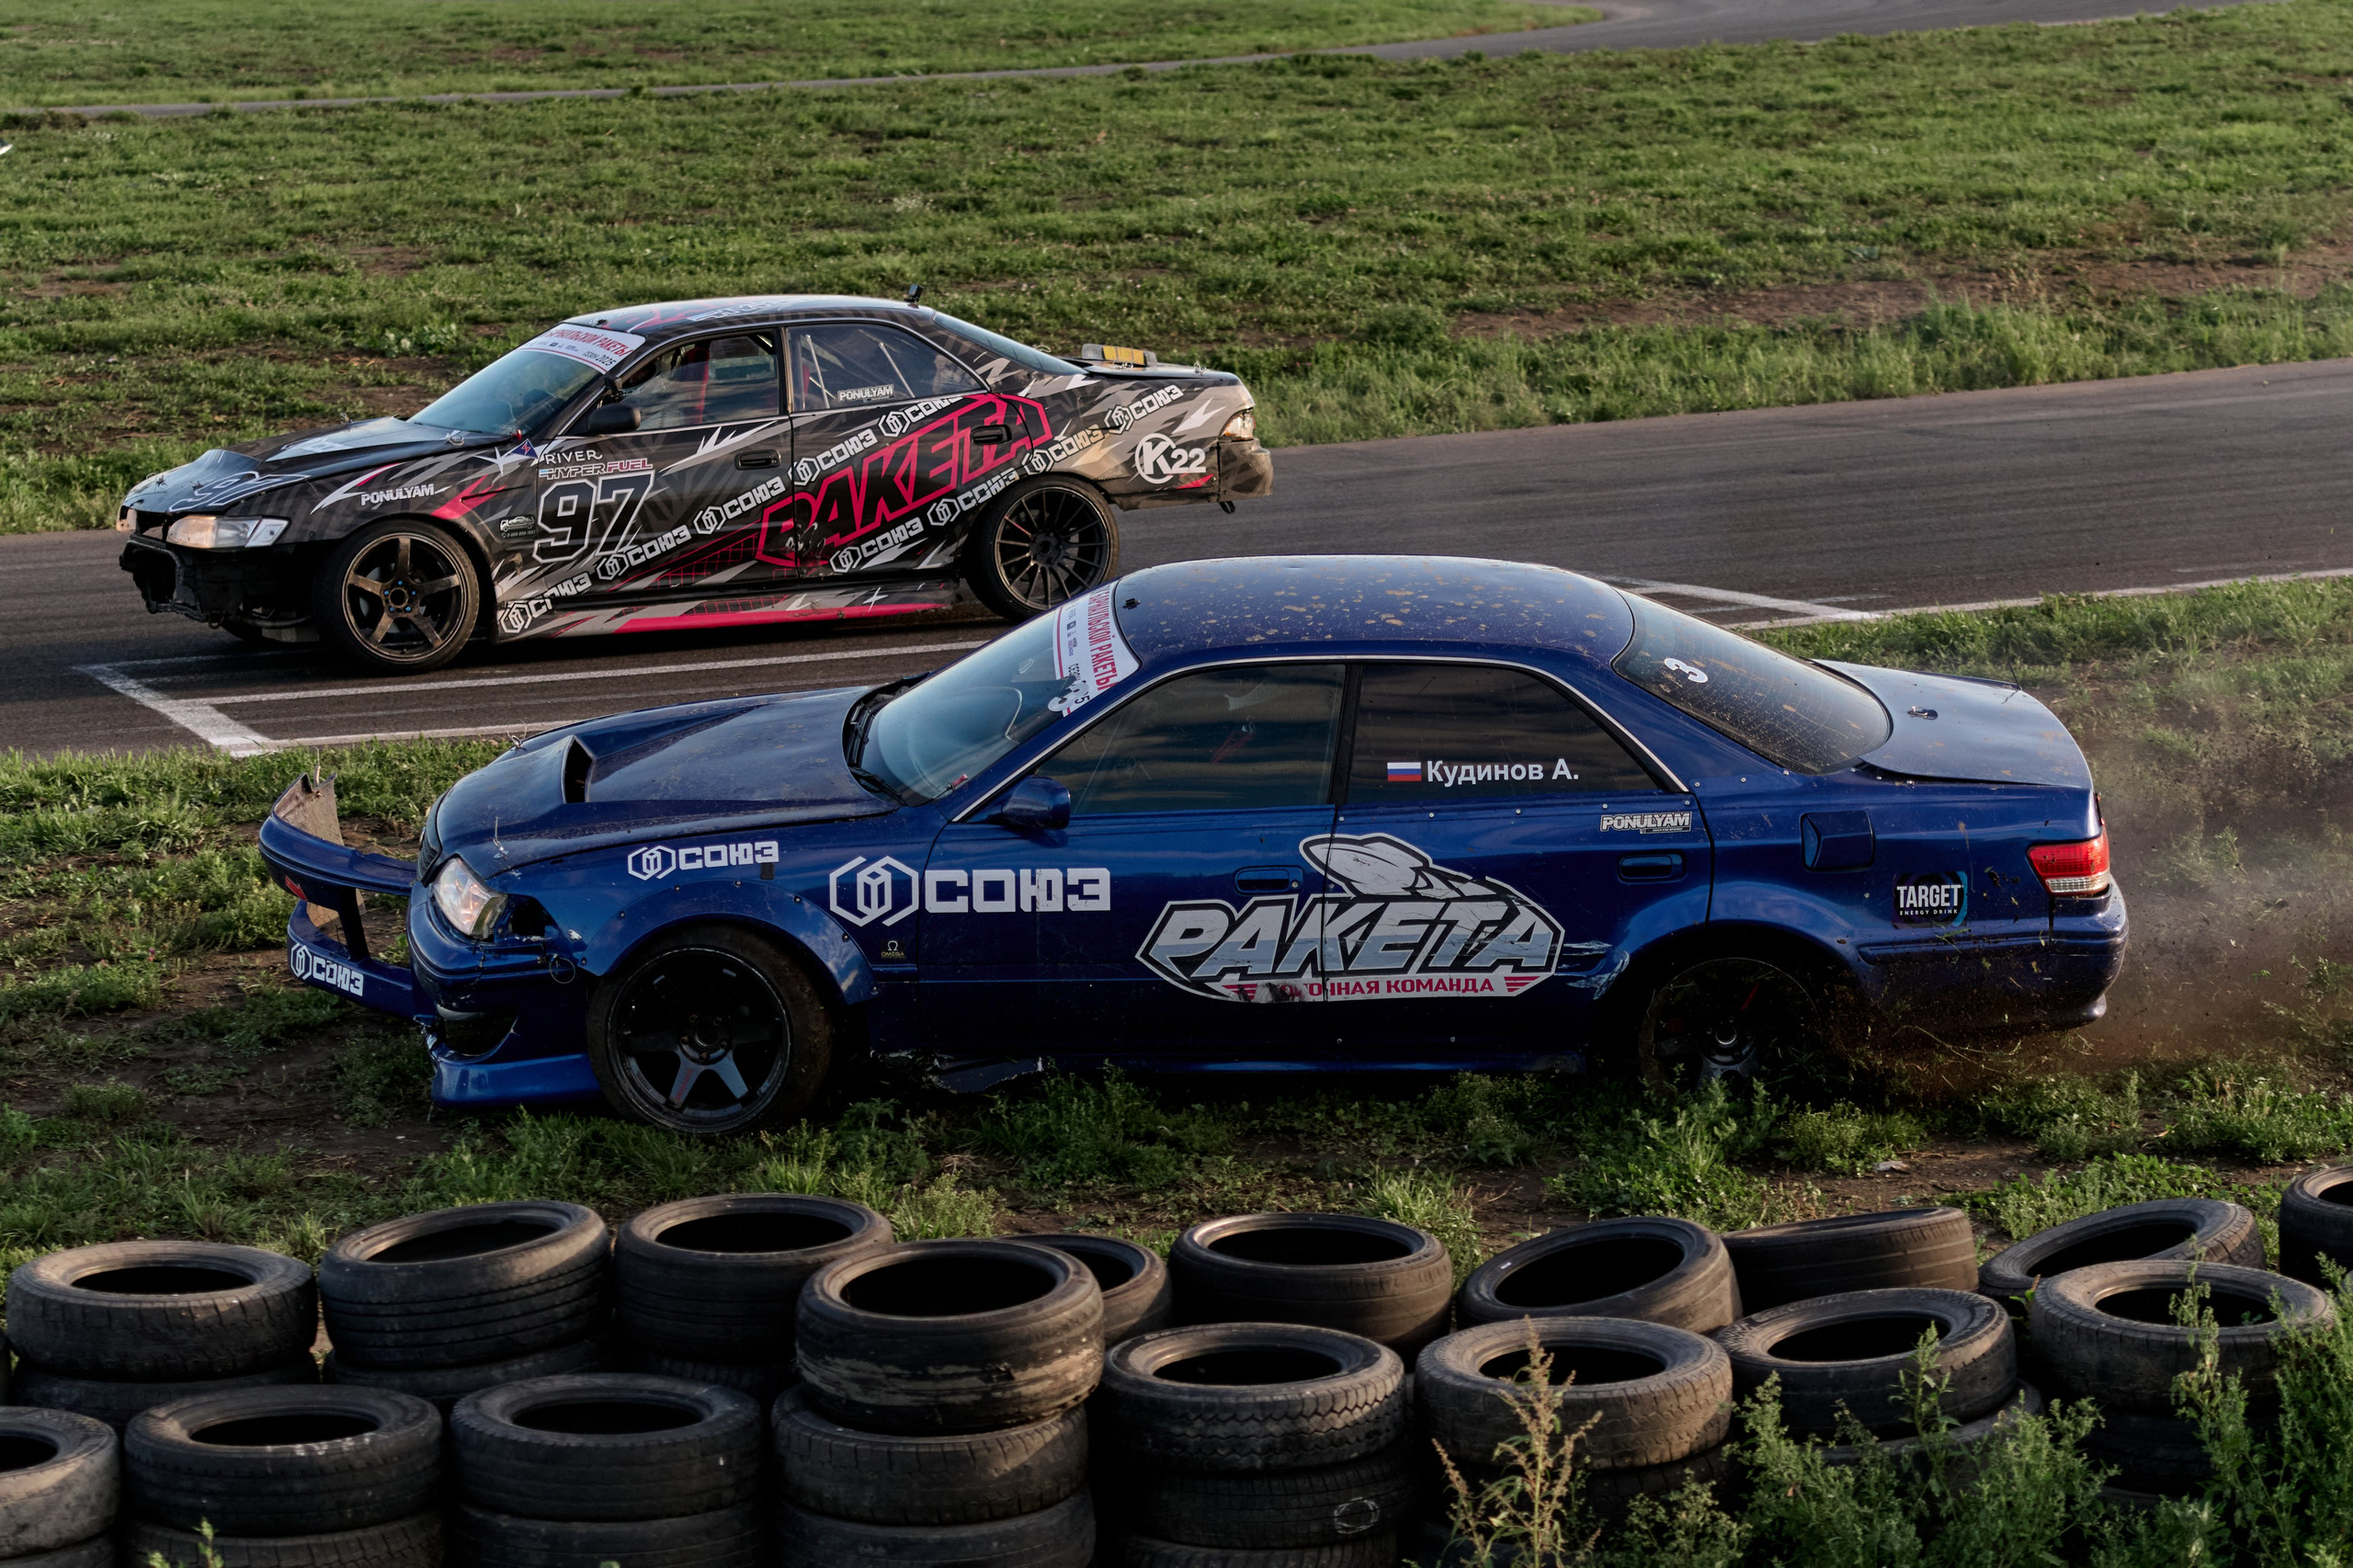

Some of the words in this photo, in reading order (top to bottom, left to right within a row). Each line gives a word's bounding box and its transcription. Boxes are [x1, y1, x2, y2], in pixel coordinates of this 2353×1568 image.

[839, 386, 893, 402] PONULYAM
[1131, 384, 1185, 420] СОЮЗ
[544, 449, 603, 465] RIVER
[816, 428, 879, 472] СОЮЗ
[1048, 424, 1105, 462] СОЮЗ
[1142, 438, 1207, 476] K22
[360, 483, 435, 506] PONULYAM
[723, 476, 787, 520] СОЮЗ
[957, 468, 1020, 512] СОЮЗ
[532, 470, 655, 563] 97
[628, 524, 691, 567] СОЮЗ
[860, 517, 924, 558] СОЮЗ
[1664, 657, 1709, 683] 3
[1427, 760, 1544, 788] Кудинов
[1552, 758, 1579, 780] А.
[1602, 812, 1690, 830] PONULYAM
[678, 841, 779, 870] СОЮЗ
[925, 868, 1110, 913] СОЮЗ
[1896, 884, 1961, 908] TARGET
[1147, 900, 1555, 978] РАКЕТА
[313, 956, 364, 997] СОЮЗ
[1386, 977, 1495, 994] КОМАНДА
